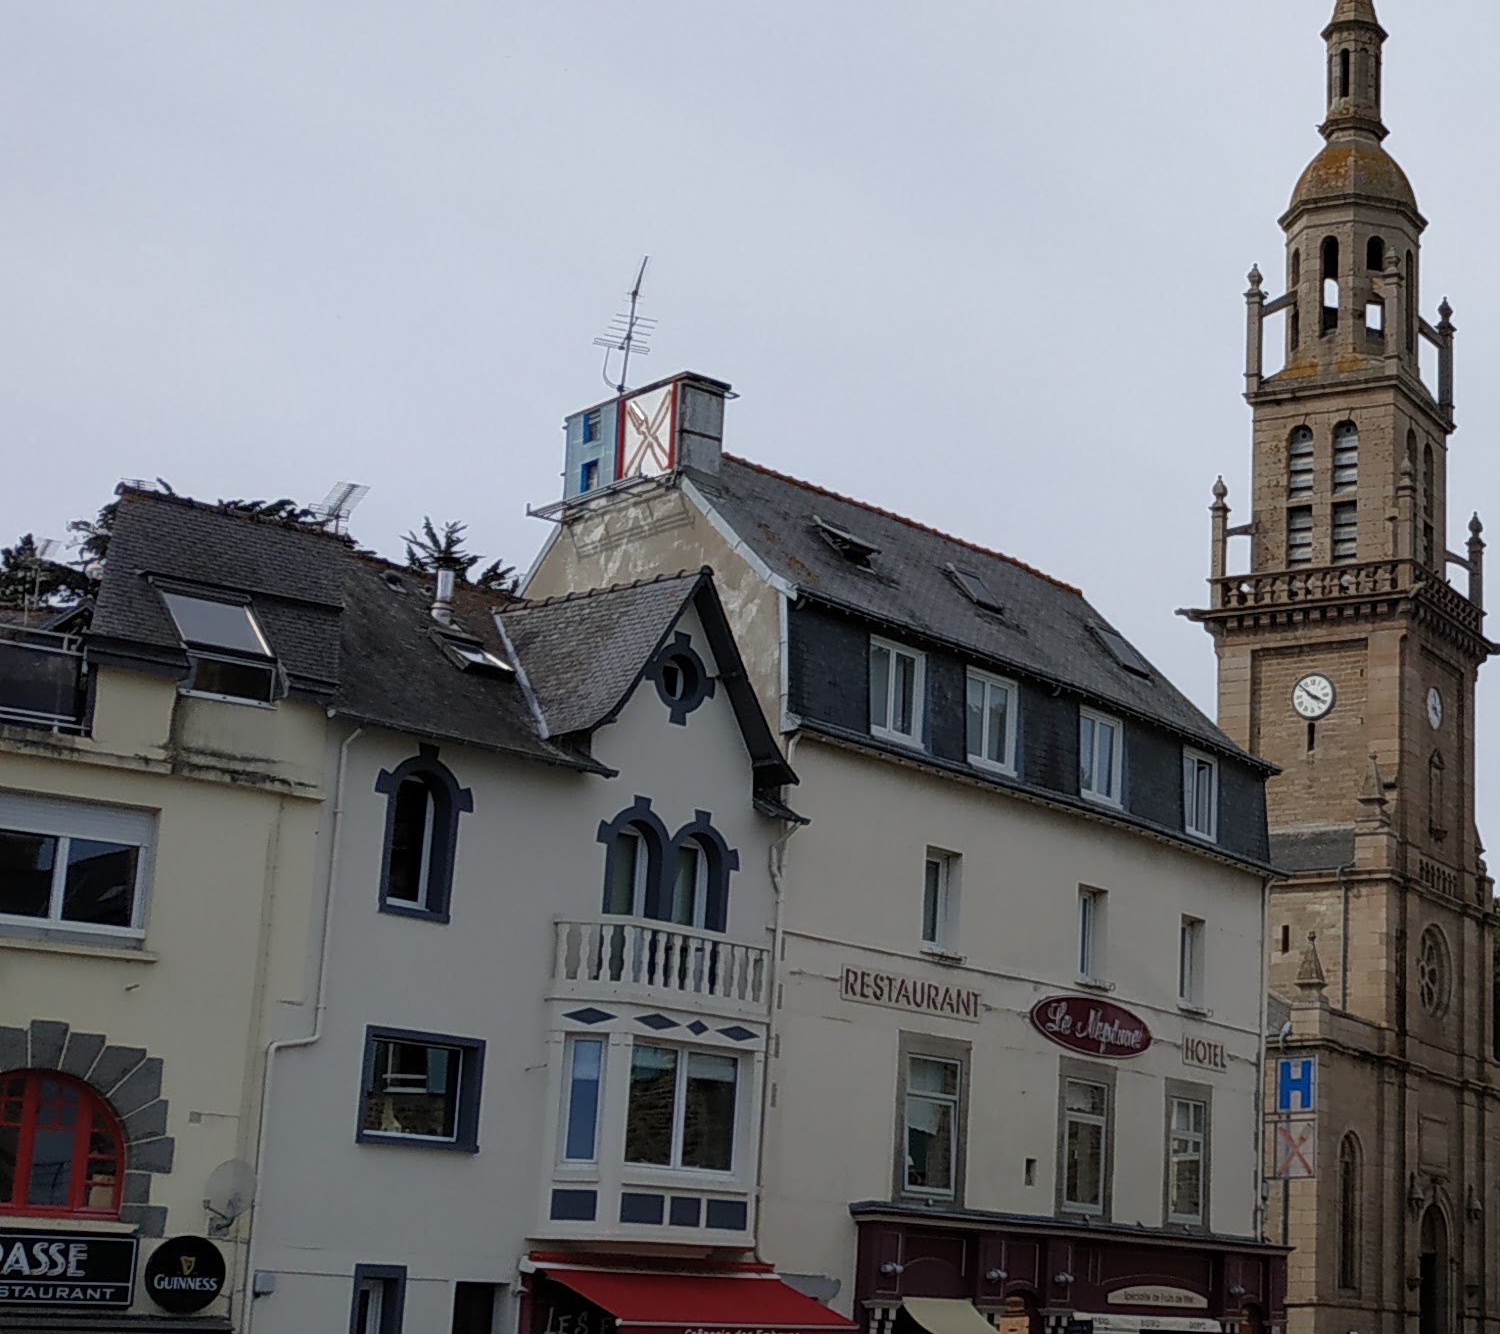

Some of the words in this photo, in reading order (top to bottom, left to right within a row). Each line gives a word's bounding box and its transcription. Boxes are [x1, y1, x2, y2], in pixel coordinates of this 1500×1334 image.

[844, 967, 982, 1018] RESTAURANT
[1045, 1001, 1072, 1034] Le
[1185, 1035, 1227, 1068] HOTEL
[1279, 1058, 1313, 1110] H
[0, 1241, 88, 1277] ASSE
[154, 1274, 218, 1291] GUINNESS
